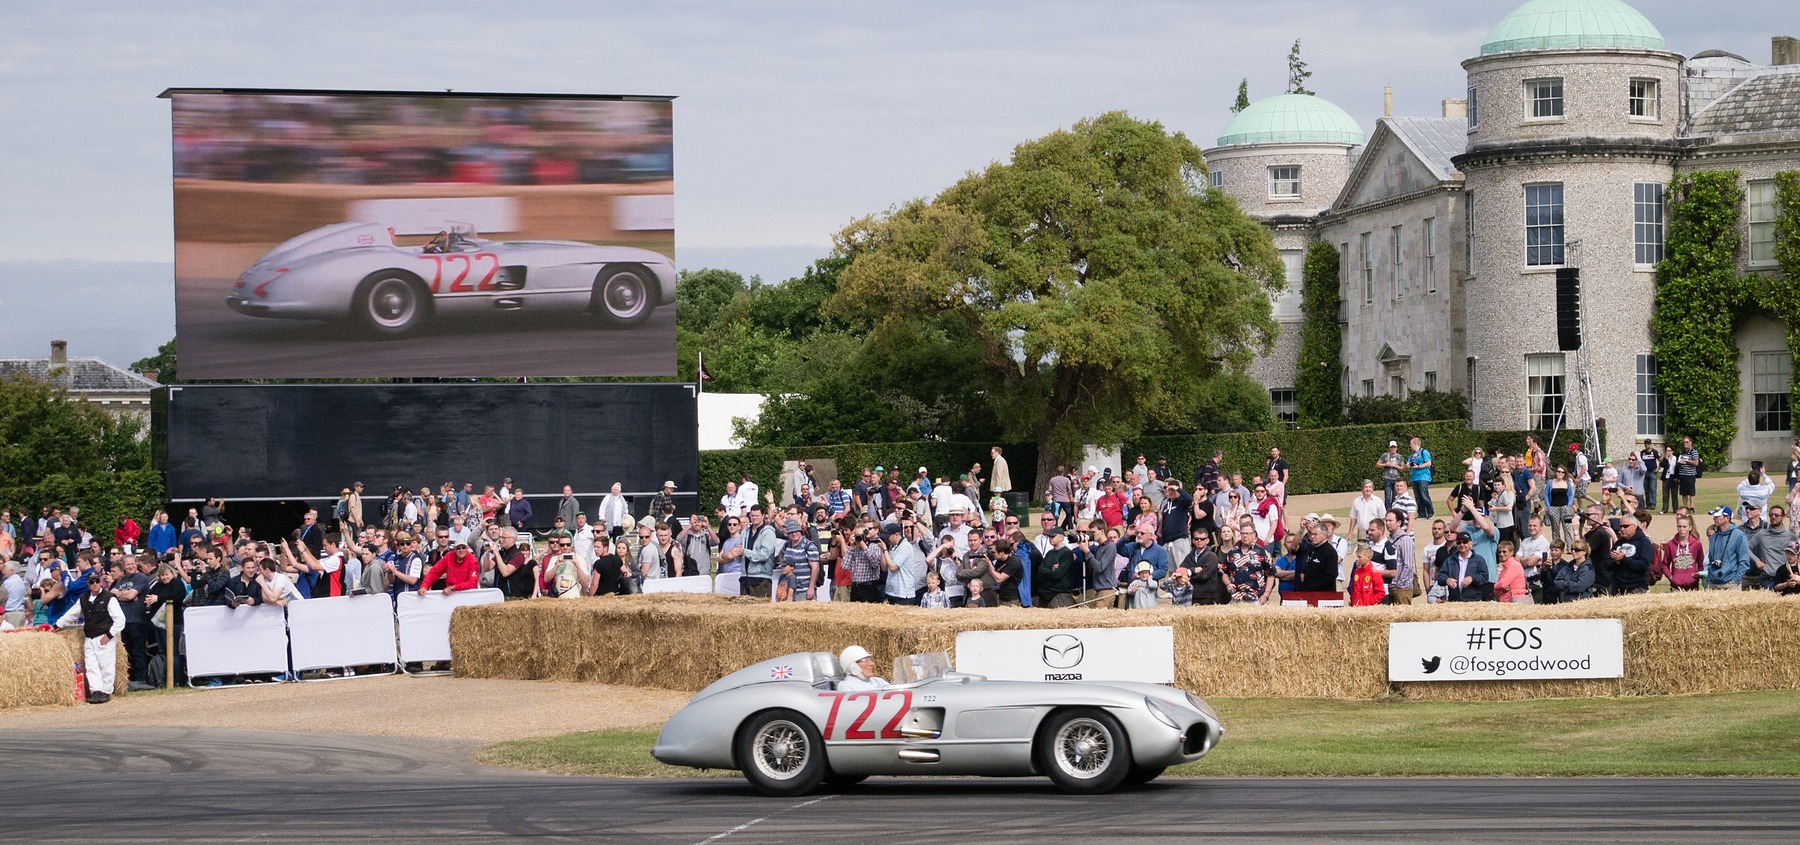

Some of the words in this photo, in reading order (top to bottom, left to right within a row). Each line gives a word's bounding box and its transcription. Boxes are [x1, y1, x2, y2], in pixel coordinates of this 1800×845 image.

[417, 252, 499, 293] 722
[1466, 627, 1543, 650] #FOS
[1449, 654, 1591, 676] @fosgoodwood
[1044, 673, 1082, 681] mazda
[818, 690, 913, 740] 722
